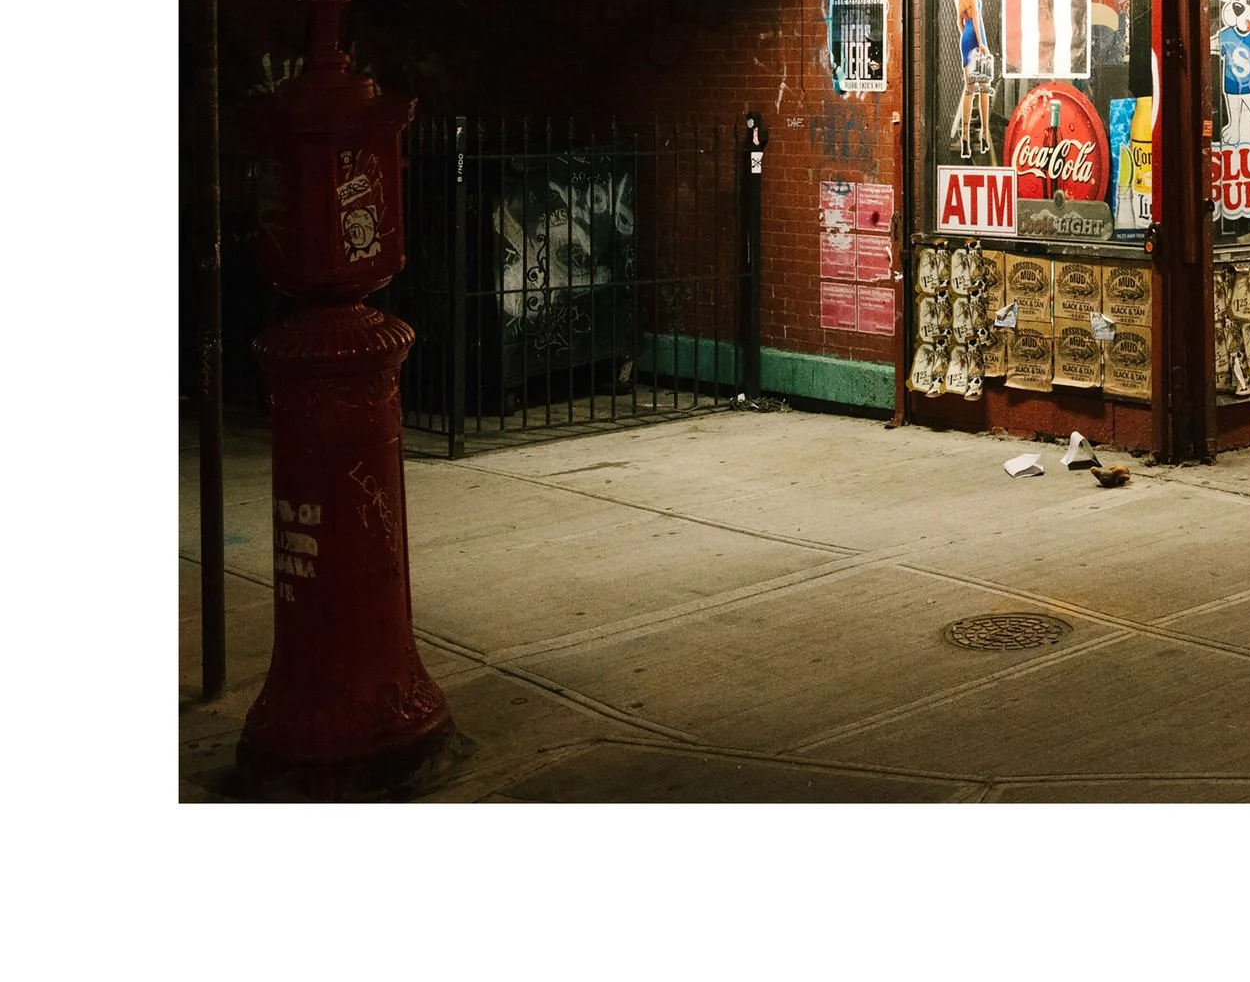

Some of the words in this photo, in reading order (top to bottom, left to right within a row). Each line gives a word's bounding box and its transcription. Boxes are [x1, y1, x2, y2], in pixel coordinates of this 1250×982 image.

[1011, 135, 1096, 183] Coca-Cola
[941, 174, 1014, 227] ATM
[1058, 219, 1104, 236] LIGHT
[1020, 270, 1036, 281] MUD
[1069, 273, 1086, 284] MUD
[1118, 276, 1136, 288] MUD
[1062, 302, 1078, 311] BLACK
[1084, 305, 1094, 313] TAN
[1111, 306, 1127, 315] BLACK
[1133, 309, 1145, 317] TAN
[1021, 337, 1037, 348] MUD
[1069, 336, 1085, 347] MUD
[1120, 342, 1138, 353] MUD
[1036, 368, 1046, 376] TAN
[1062, 365, 1078, 373] BLACK
[1083, 368, 1094, 376] TAN
[1136, 374, 1147, 382] TAN
